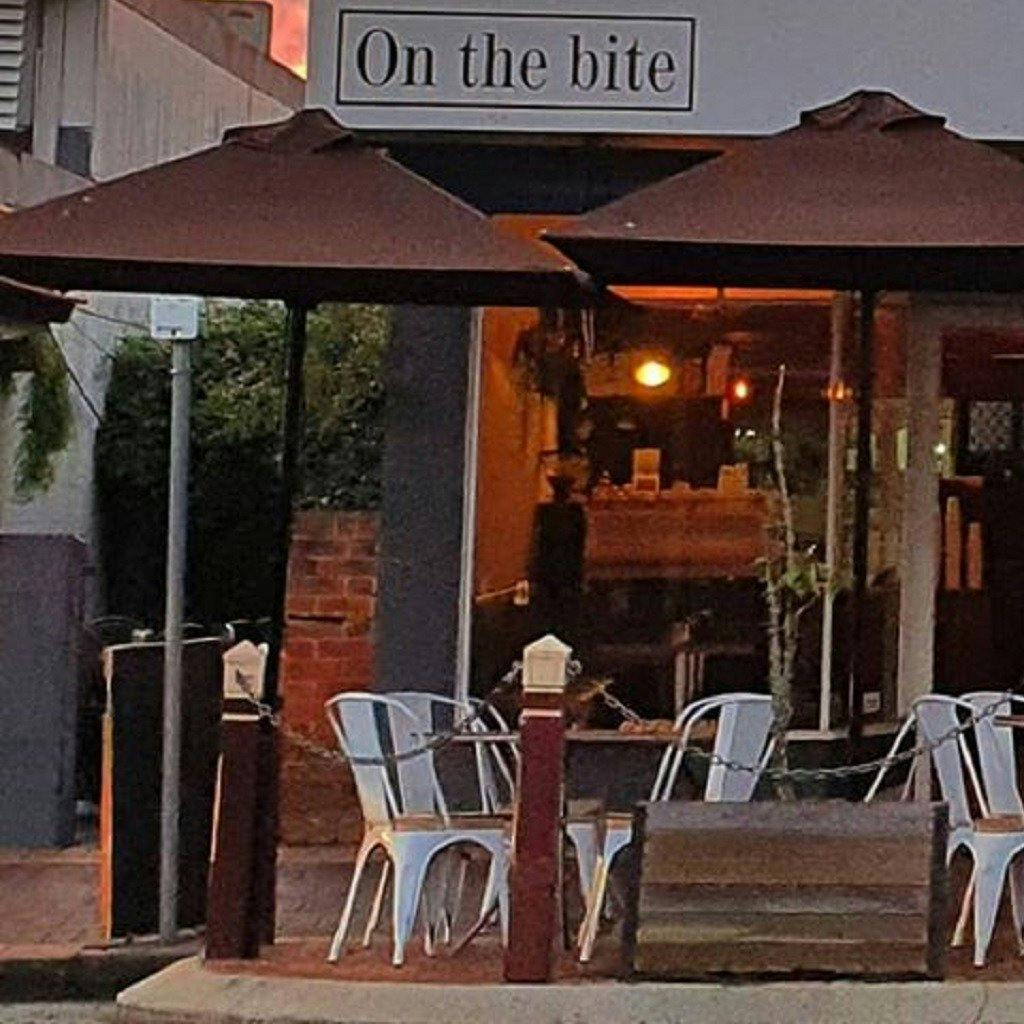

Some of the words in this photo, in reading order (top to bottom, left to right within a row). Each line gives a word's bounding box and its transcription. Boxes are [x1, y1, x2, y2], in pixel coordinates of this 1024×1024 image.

[356, 27, 435, 87] On
[460, 32, 547, 90] the
[569, 34, 676, 93] bite
